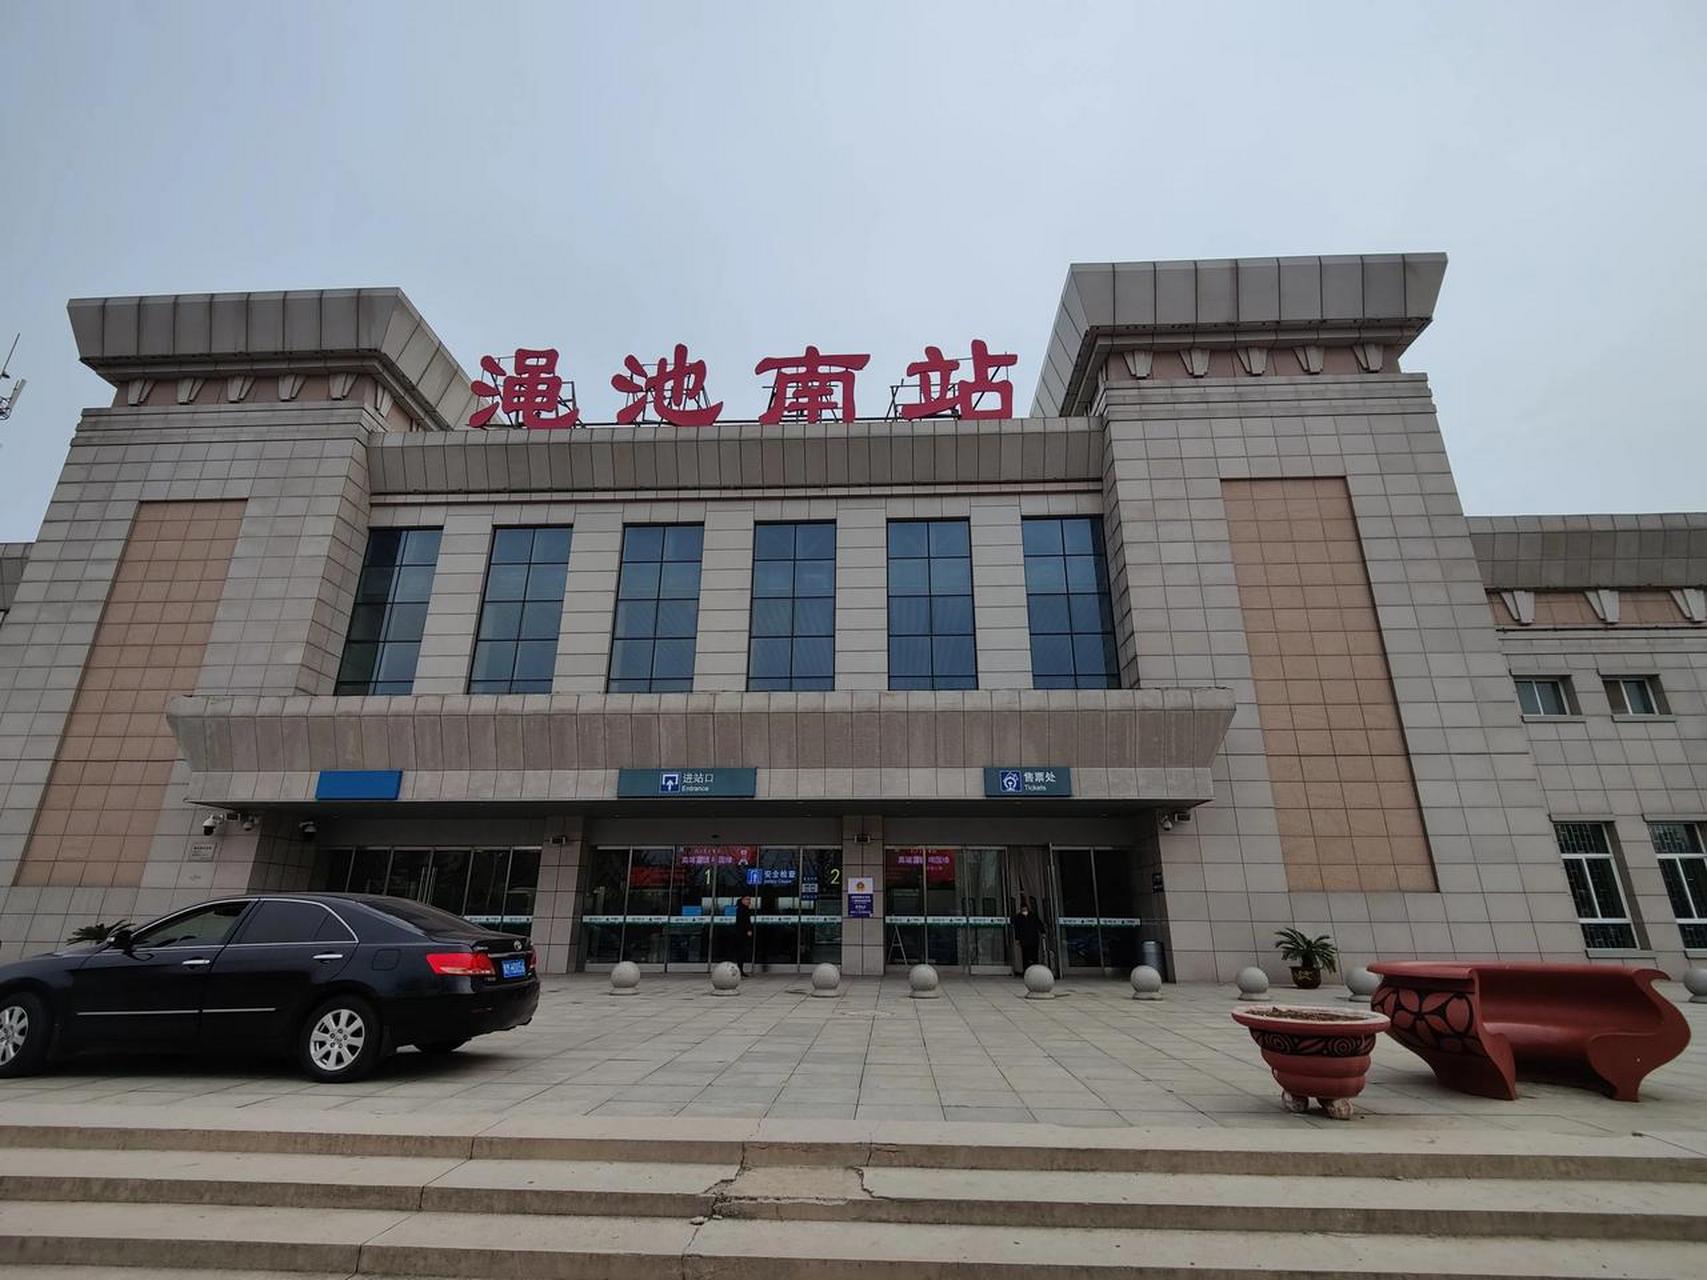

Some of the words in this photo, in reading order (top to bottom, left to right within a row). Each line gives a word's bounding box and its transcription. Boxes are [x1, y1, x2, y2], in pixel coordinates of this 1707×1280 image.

[469, 339, 1018, 428] 渑池南站
[682, 773, 714, 784] 进站口
[1023, 771, 1056, 783] 售票处
[704, 868, 711, 885] 1
[763, 869, 796, 879] 安全检查
[829, 867, 841, 885] 2
